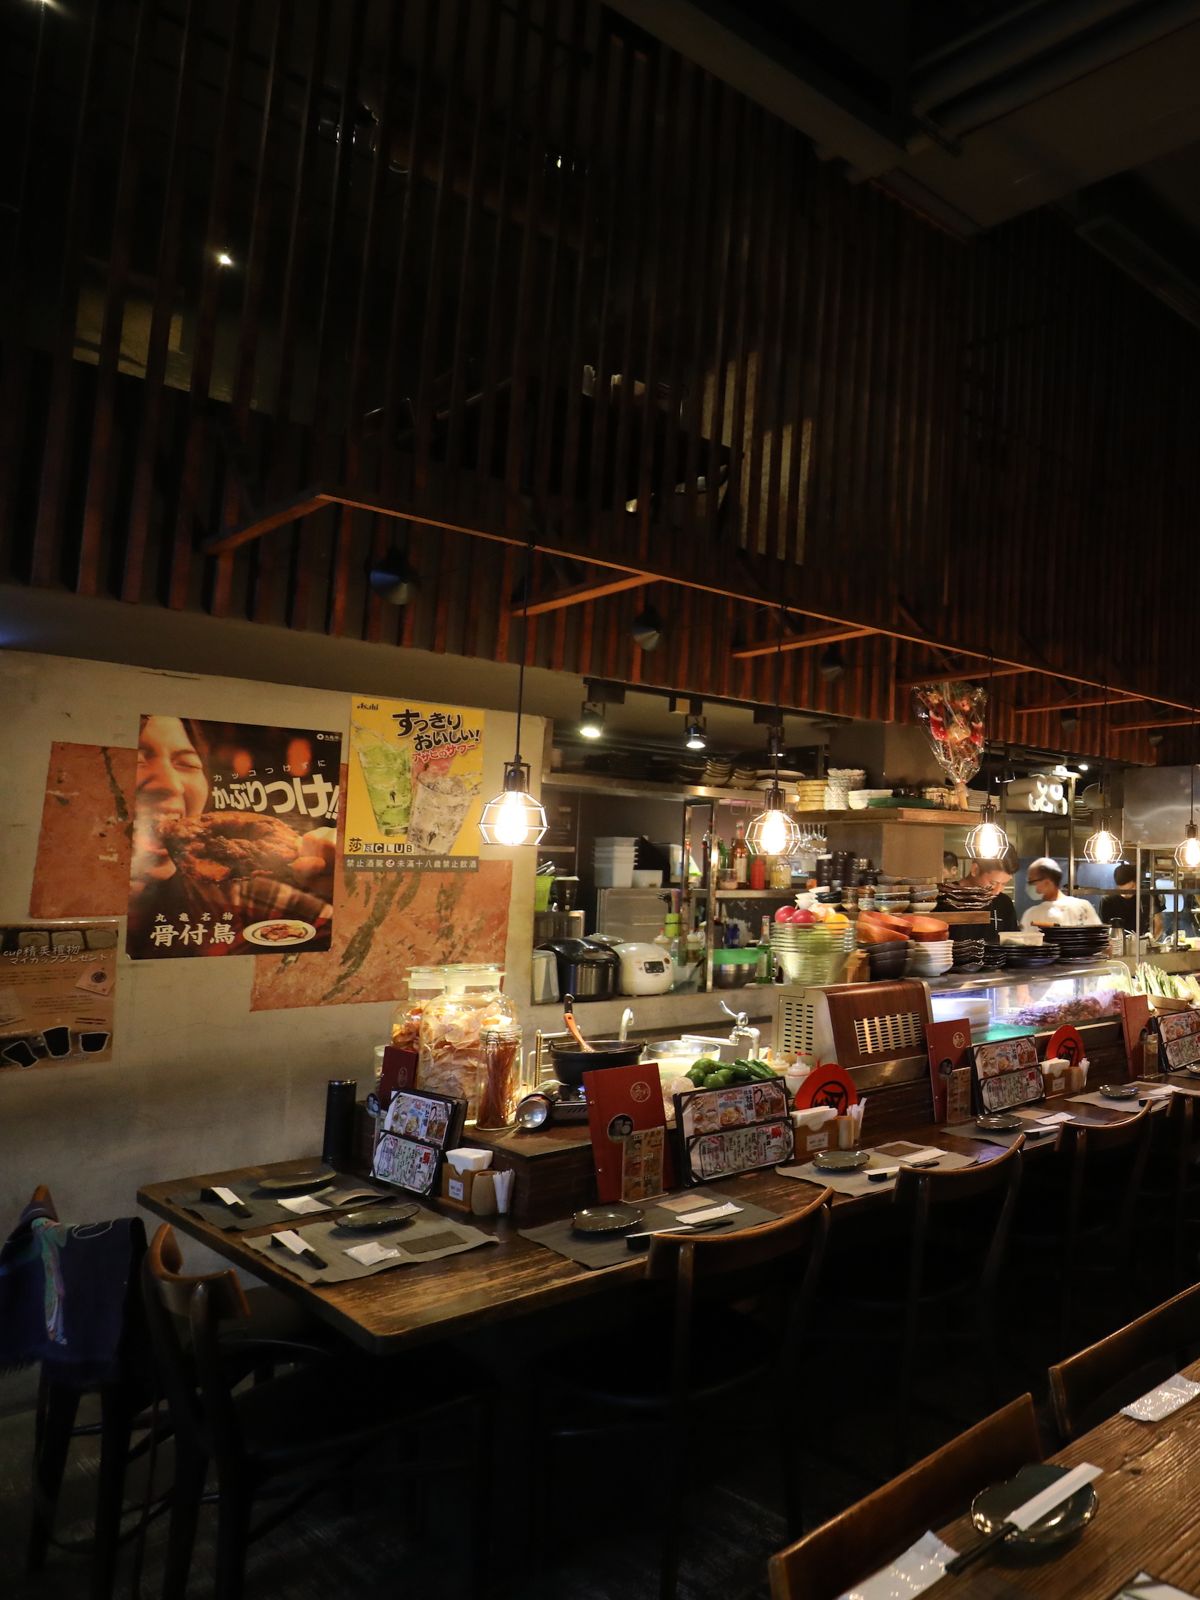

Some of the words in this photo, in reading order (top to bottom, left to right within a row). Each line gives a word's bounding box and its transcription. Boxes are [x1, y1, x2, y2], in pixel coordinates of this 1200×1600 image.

[392, 708, 462, 737] すっきり
[150, 922, 236, 947] 骨付鳥
